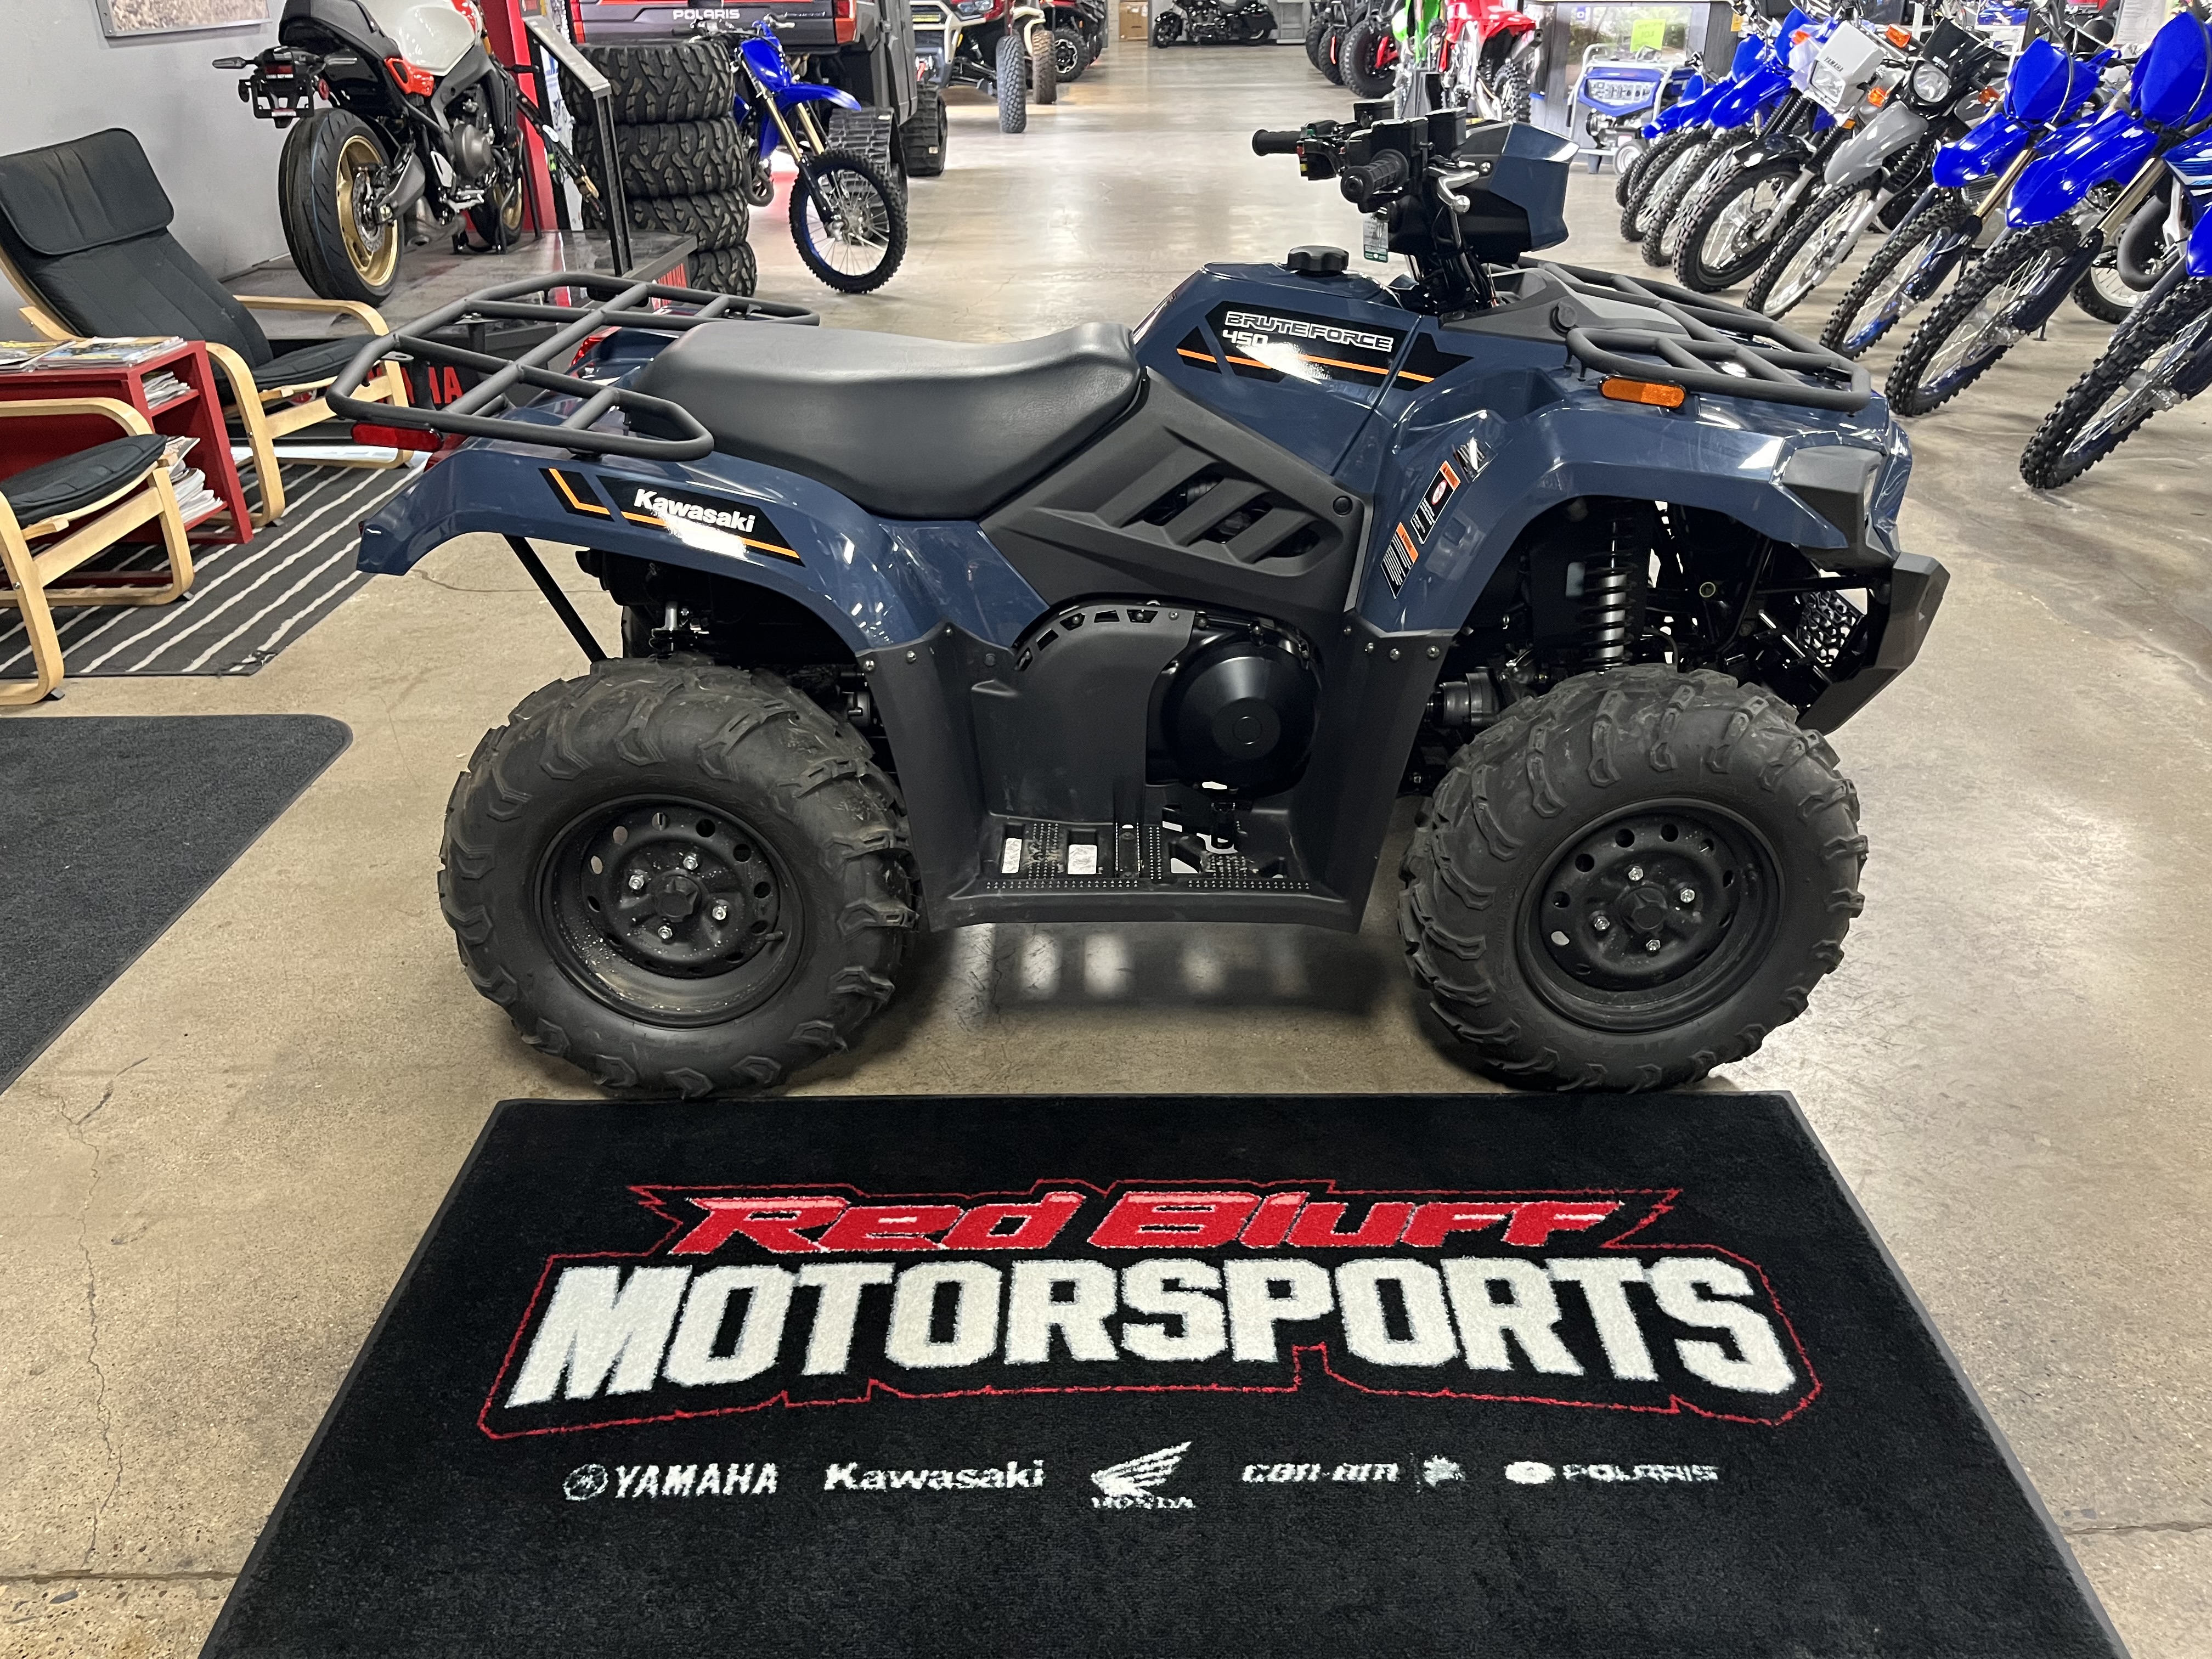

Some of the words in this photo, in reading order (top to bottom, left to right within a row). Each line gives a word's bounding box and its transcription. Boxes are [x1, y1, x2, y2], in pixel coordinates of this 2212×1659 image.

[673, 9, 741, 20] POLARIS
[1222, 329, 1269, 347] 450
[1224, 311, 1310, 338] BRUTE
[1308, 324, 1394, 352] FORCE
[634, 489, 755, 532] Kawasaki
[504, 1255, 1797, 1408] MOTORSPORTS
[616, 1463, 777, 1498] YAMAHA
[824, 1459, 1044, 1491] Kawasaki
[1563, 1464, 1718, 1483] POLARIS
